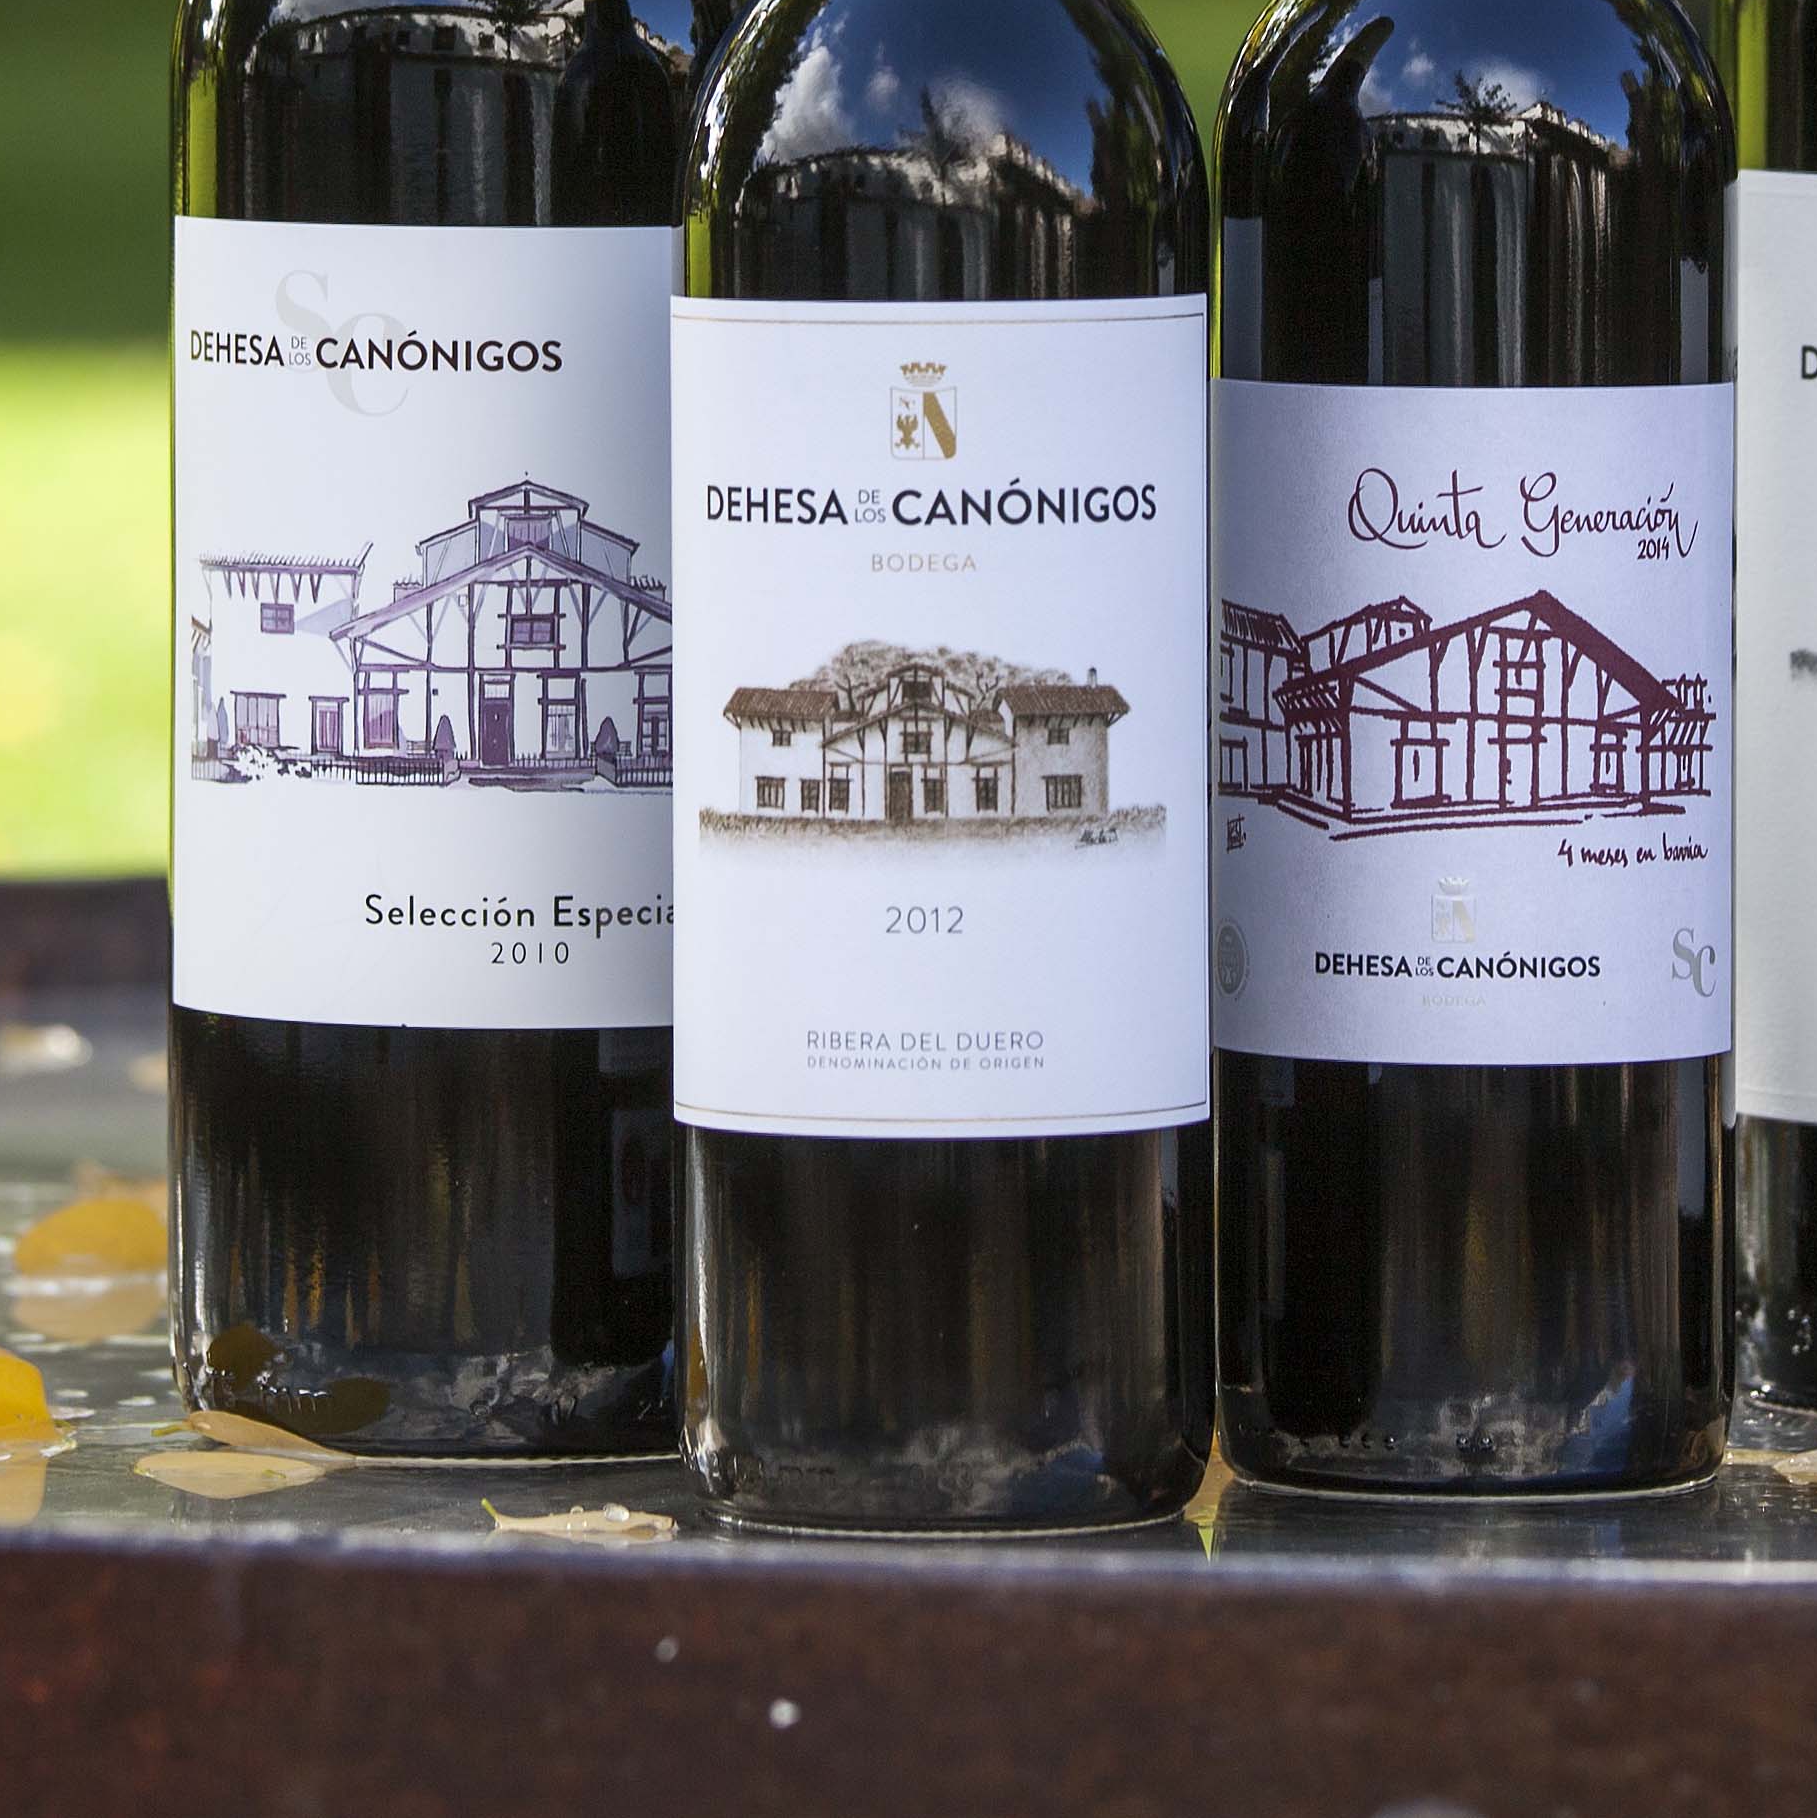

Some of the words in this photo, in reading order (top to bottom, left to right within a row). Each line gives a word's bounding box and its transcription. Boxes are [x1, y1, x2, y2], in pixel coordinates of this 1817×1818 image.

[190, 329, 285, 367] DEHESA
[291, 336, 307, 350] DE
[315, 330, 563, 372] CANÓNIGOS
[288, 352, 312, 367] LOS
[707, 484, 849, 526] DEHESA
[858, 489, 881, 505] DE
[892, 477, 1158, 526] CANÓNIGOS
[854, 507, 887, 524] LOS
[1348, 467, 1507, 550] Quinta
[1519, 471, 1698, 559] Generación
[1637, 537, 1670, 561] 2014
[871, 553, 977, 573] BODEGA
[1557, 838, 1574, 868] 4
[1580, 846, 1629, 869] meses
[1636, 846, 1657, 864] en
[365, 894, 536, 927] Selección
[553, 894, 674, 939] Especia
[885, 906, 964, 934] 2012
[491, 942, 570, 965] 2010
[1315, 951, 1413, 978] DEHESA
[1417, 956, 1431, 966] DE
[1436, 951, 1601, 979] CANÓNIGOS
[1672, 928, 1717, 998] SC
[1414, 967, 1434, 977] LOS
[806, 1030, 891, 1051] RIBERA
[901, 1032, 947, 1052] DEL
[957, 1030, 1044, 1052] DUERO
[806, 1055, 942, 1071] DENOMINACIÓN
[950, 1057, 971, 1071] DE
[979, 1055, 1045, 1071] ORIGEN
